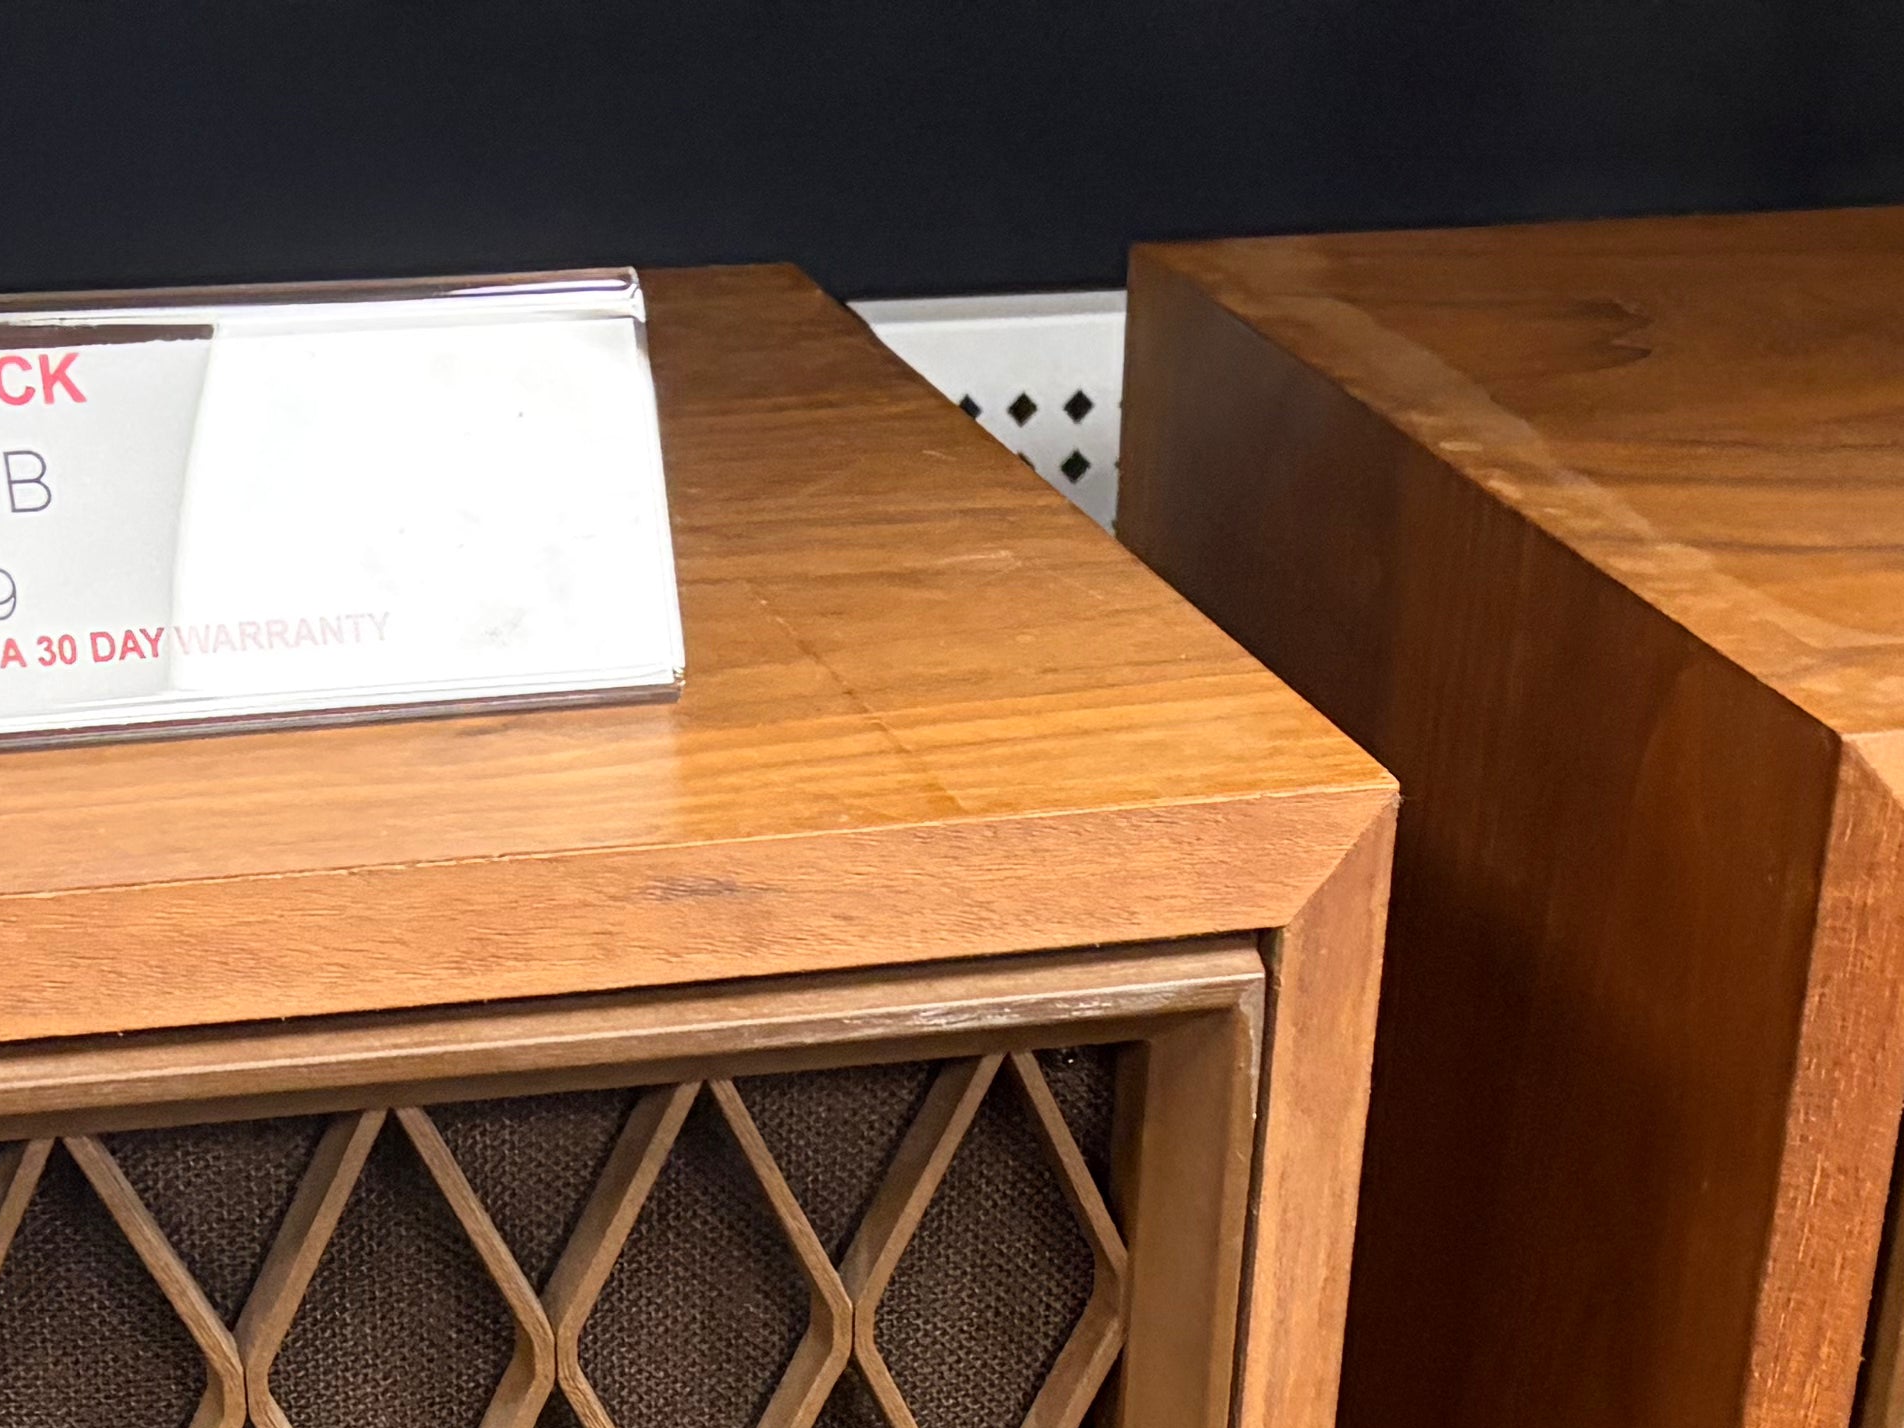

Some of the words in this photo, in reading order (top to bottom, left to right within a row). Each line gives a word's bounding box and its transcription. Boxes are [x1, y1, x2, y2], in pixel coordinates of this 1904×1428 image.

[35, 633, 79, 668] 30
[89, 626, 166, 664] DAY
[175, 611, 391, 657] WARRANTY
